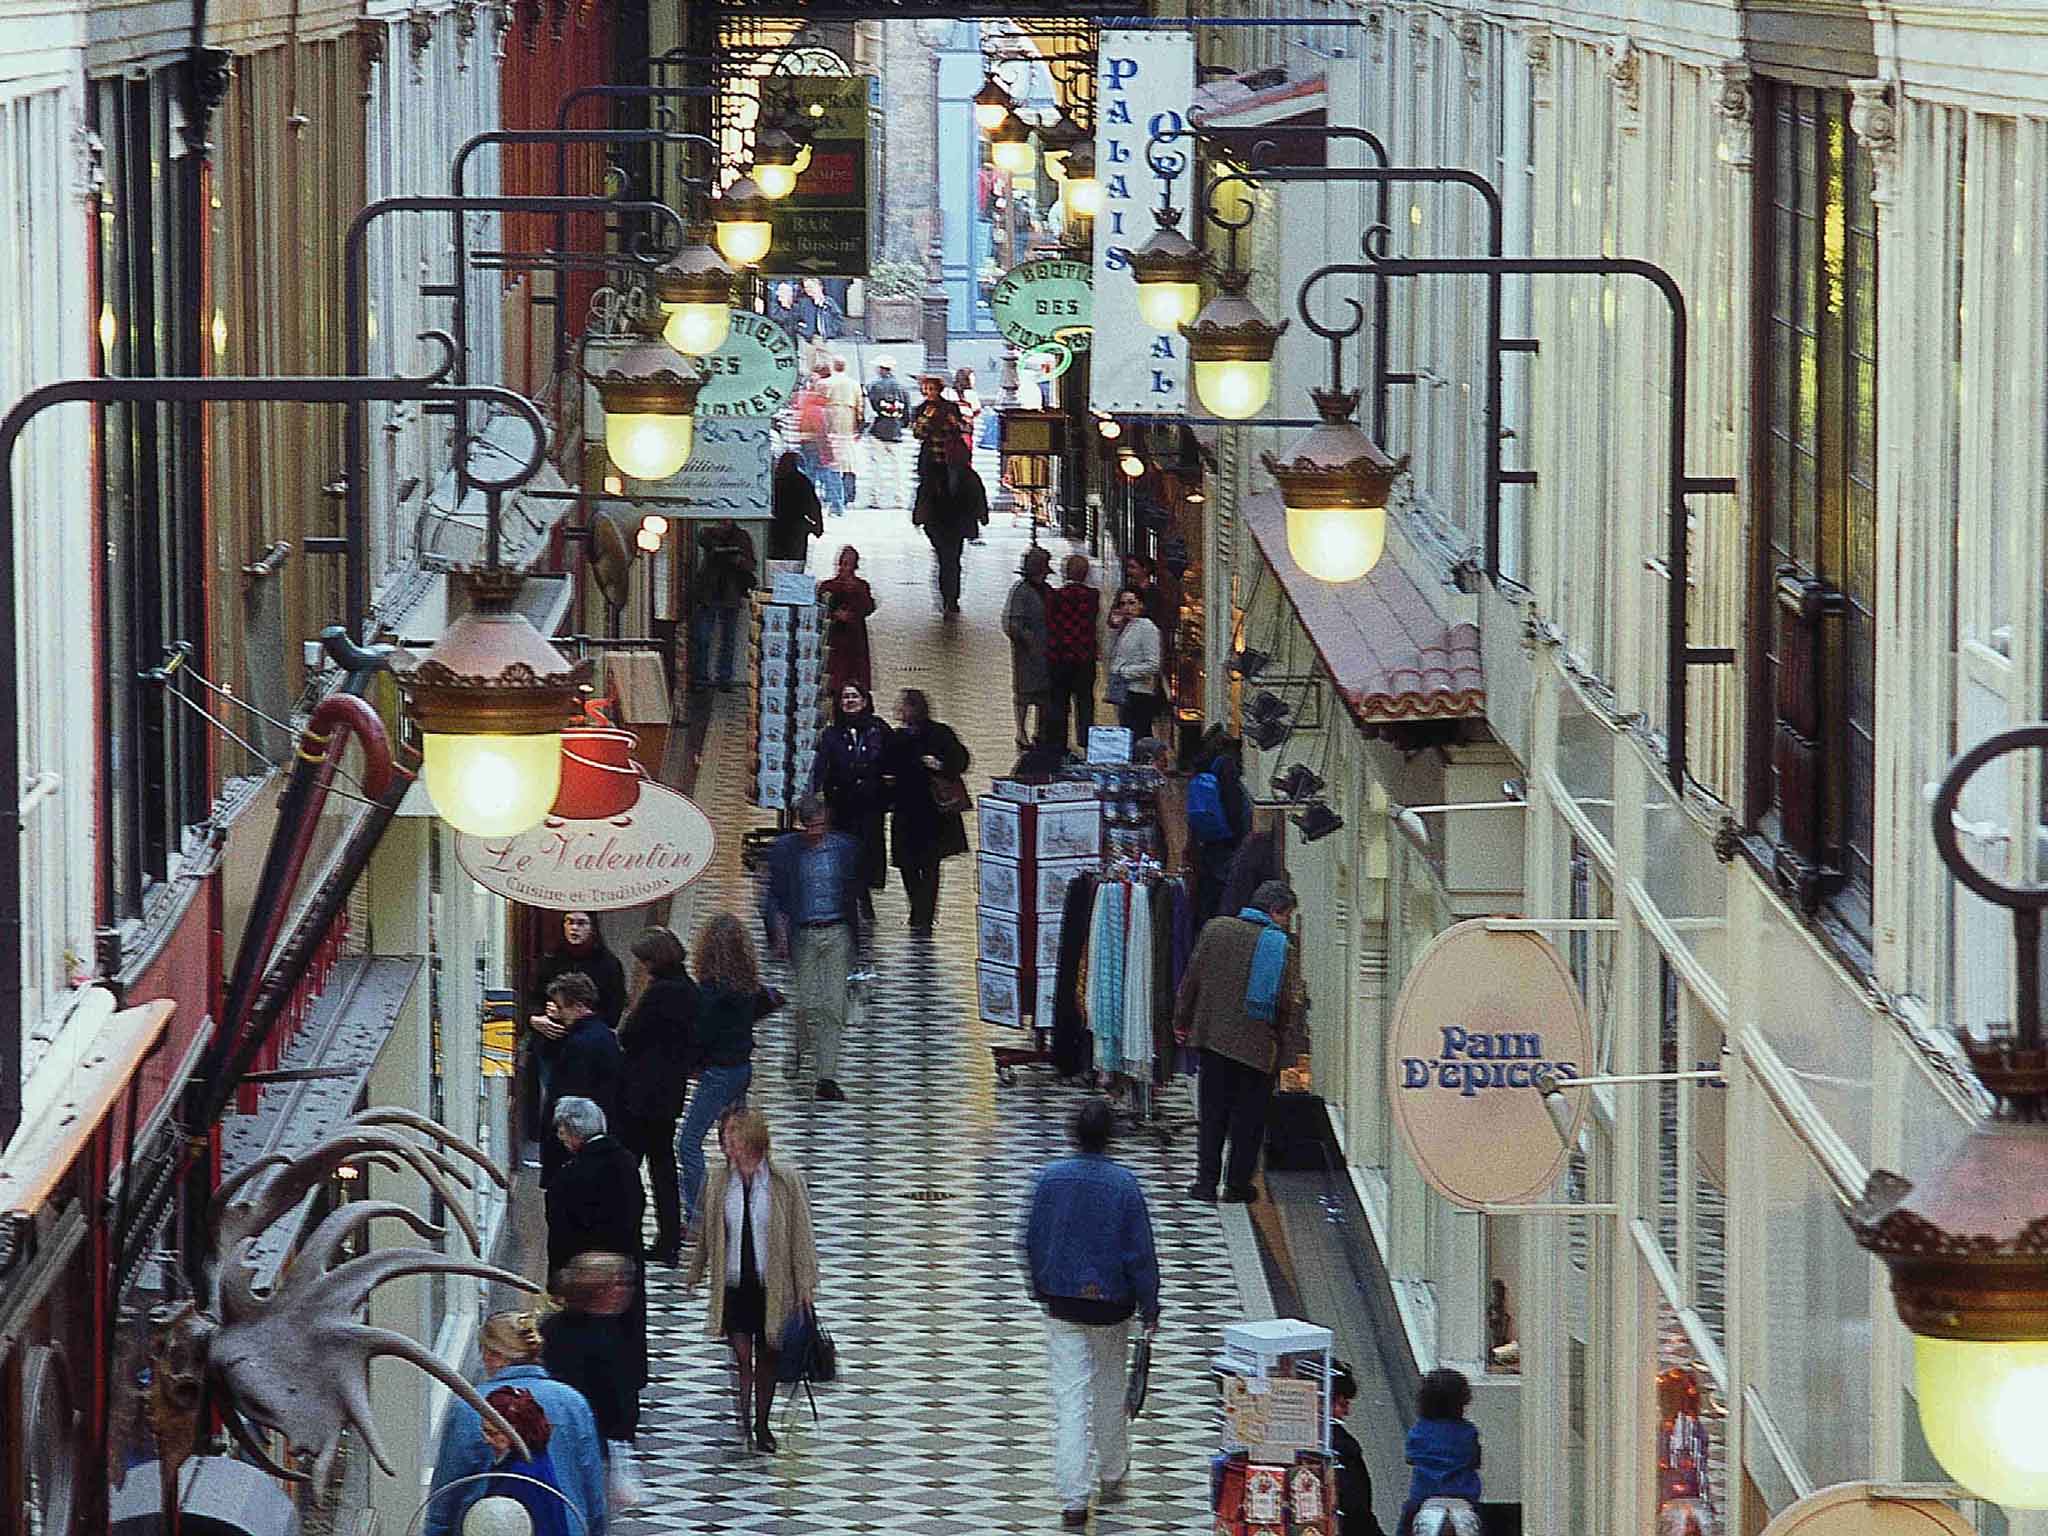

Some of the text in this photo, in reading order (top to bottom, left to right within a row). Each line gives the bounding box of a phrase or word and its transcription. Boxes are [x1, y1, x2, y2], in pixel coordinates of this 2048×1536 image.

[1102, 57, 1138, 270] PALAIS
[542, 832, 693, 873] Valentin
[505, 875, 564, 901] Cuisine
[1440, 1025, 1543, 1060] Pain
